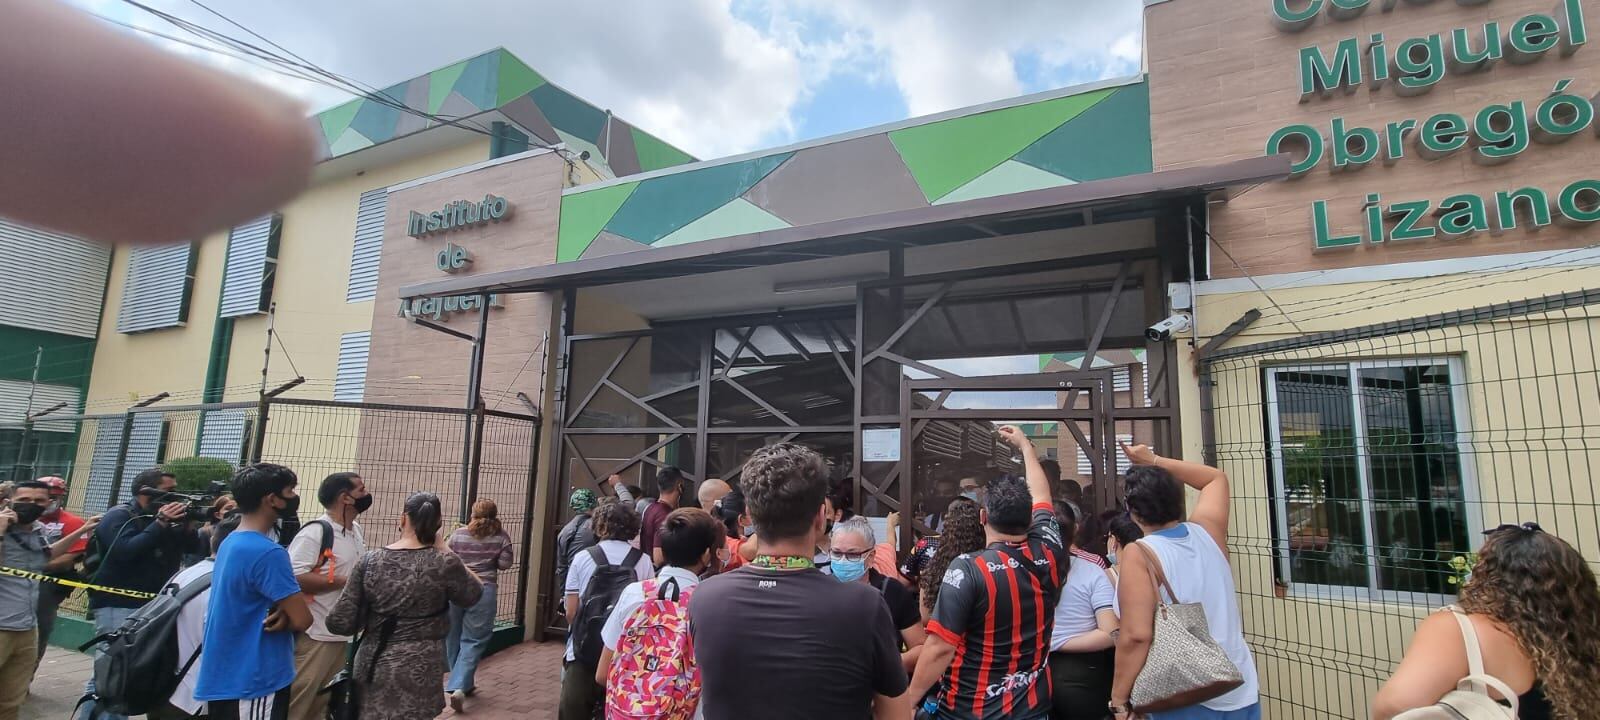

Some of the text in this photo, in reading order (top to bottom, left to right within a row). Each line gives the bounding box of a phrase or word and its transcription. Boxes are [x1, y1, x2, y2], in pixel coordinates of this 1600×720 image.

[1298, 0, 1587, 95] Miguel
[1265, 78, 1600, 174] Obregó
[408, 193, 508, 236] Instituto
[1312, 179, 1600, 249] Lizano
[436, 242, 467, 271] de
